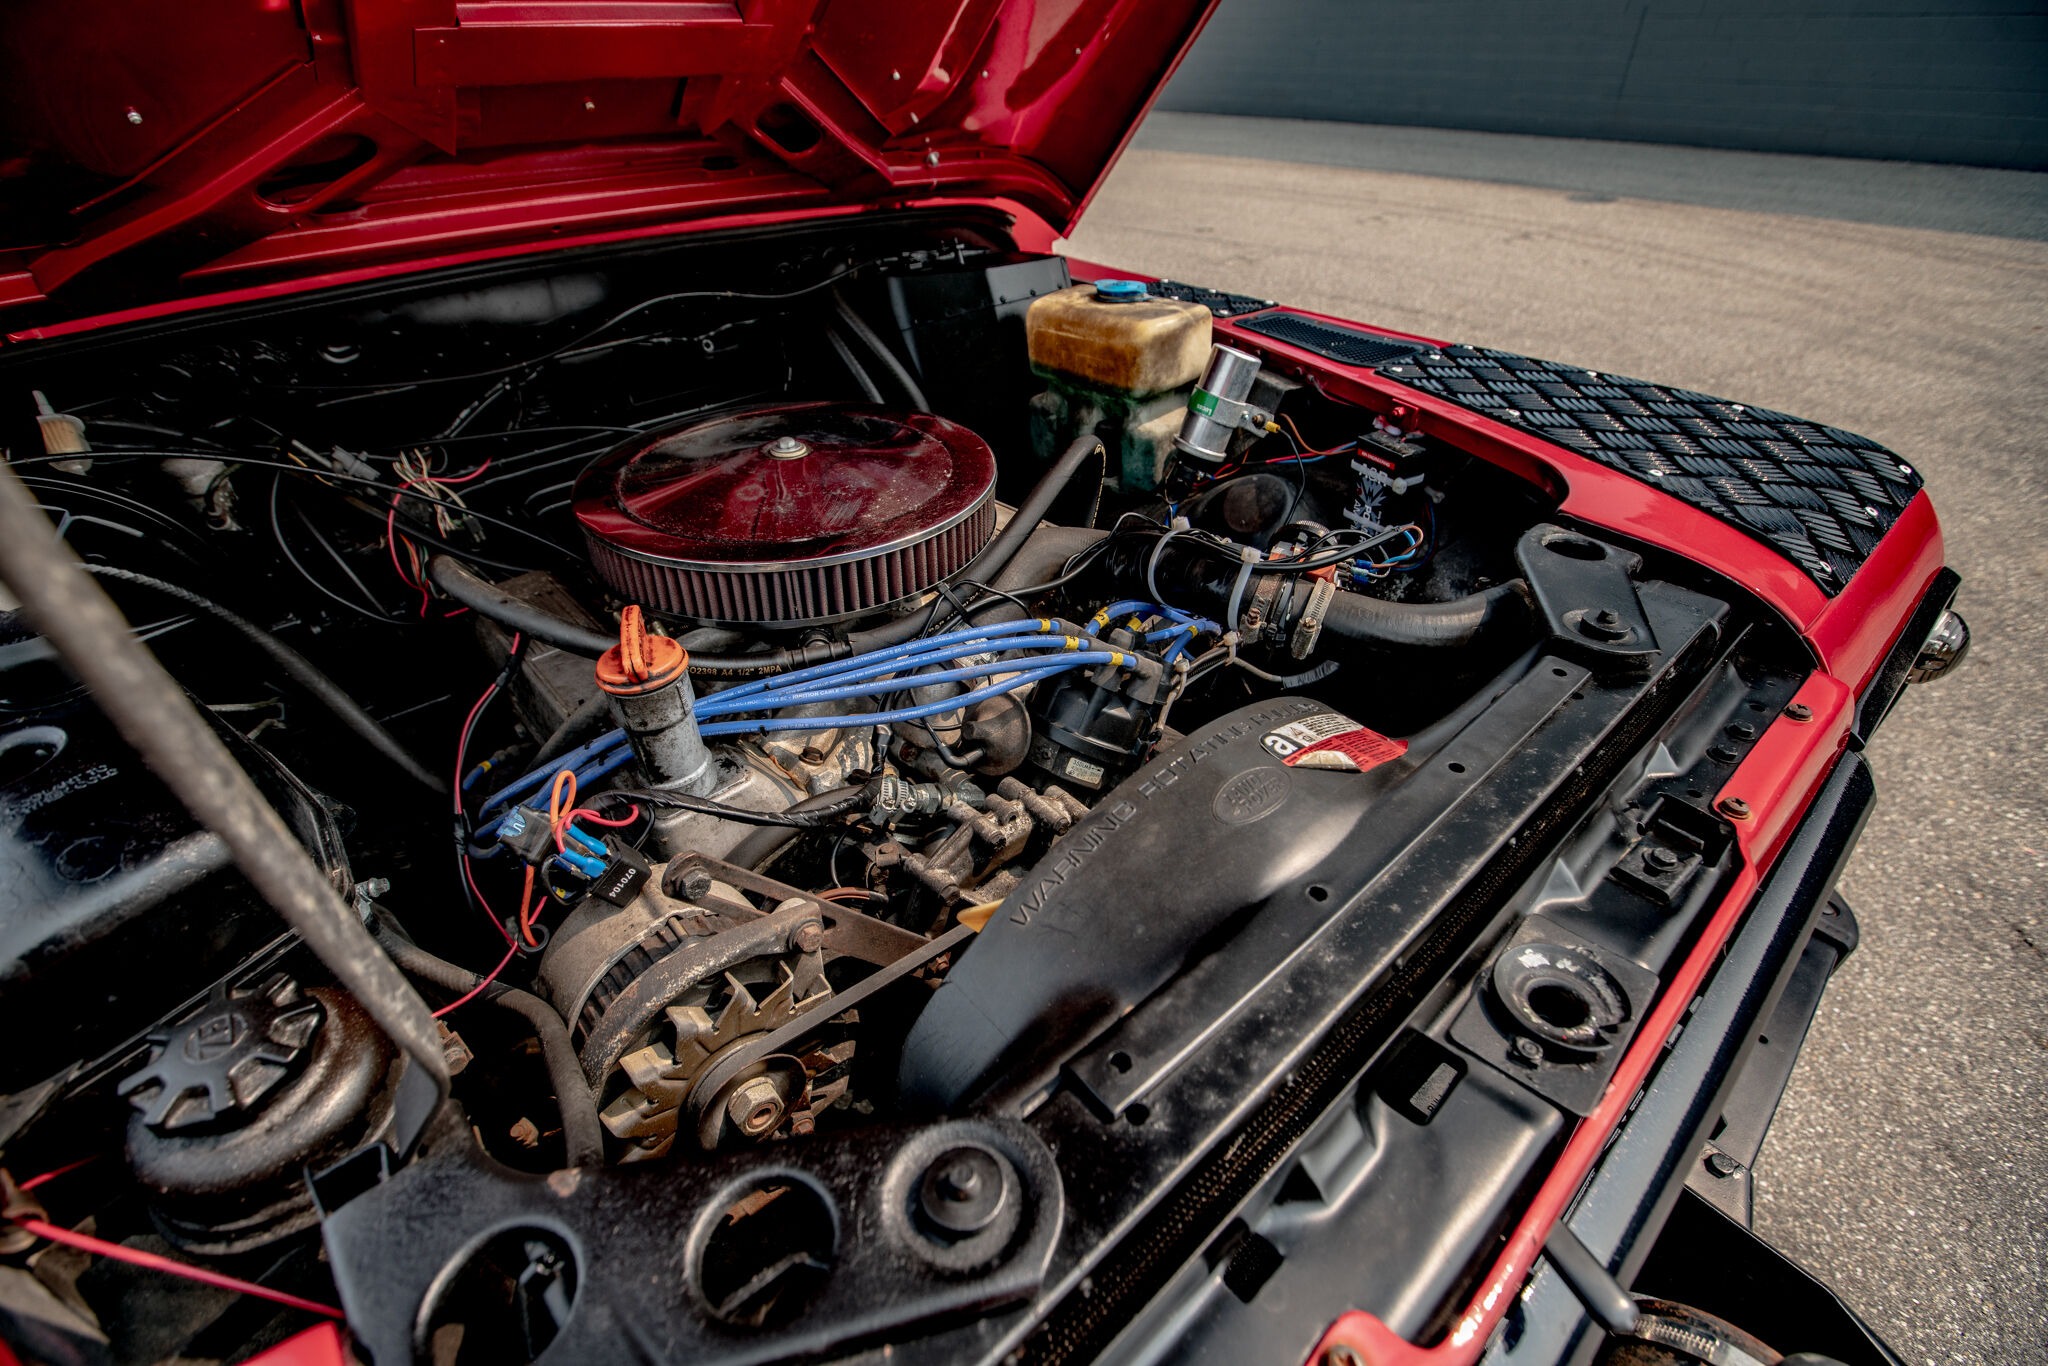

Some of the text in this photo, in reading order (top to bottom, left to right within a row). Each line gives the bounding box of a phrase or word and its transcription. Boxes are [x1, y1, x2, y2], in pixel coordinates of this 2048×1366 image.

[906, 639, 933, 651] IGNITION
[721, 669, 733, 677] A4
[758, 664, 782, 675] 2MPA
[792, 690, 820, 700] IGNITION
[820, 688, 840, 696] CABLE
[1008, 800, 1138, 927] WARNING
[1137, 720, 1250, 800] ROTATING
[608, 868, 637, 898] 070104
